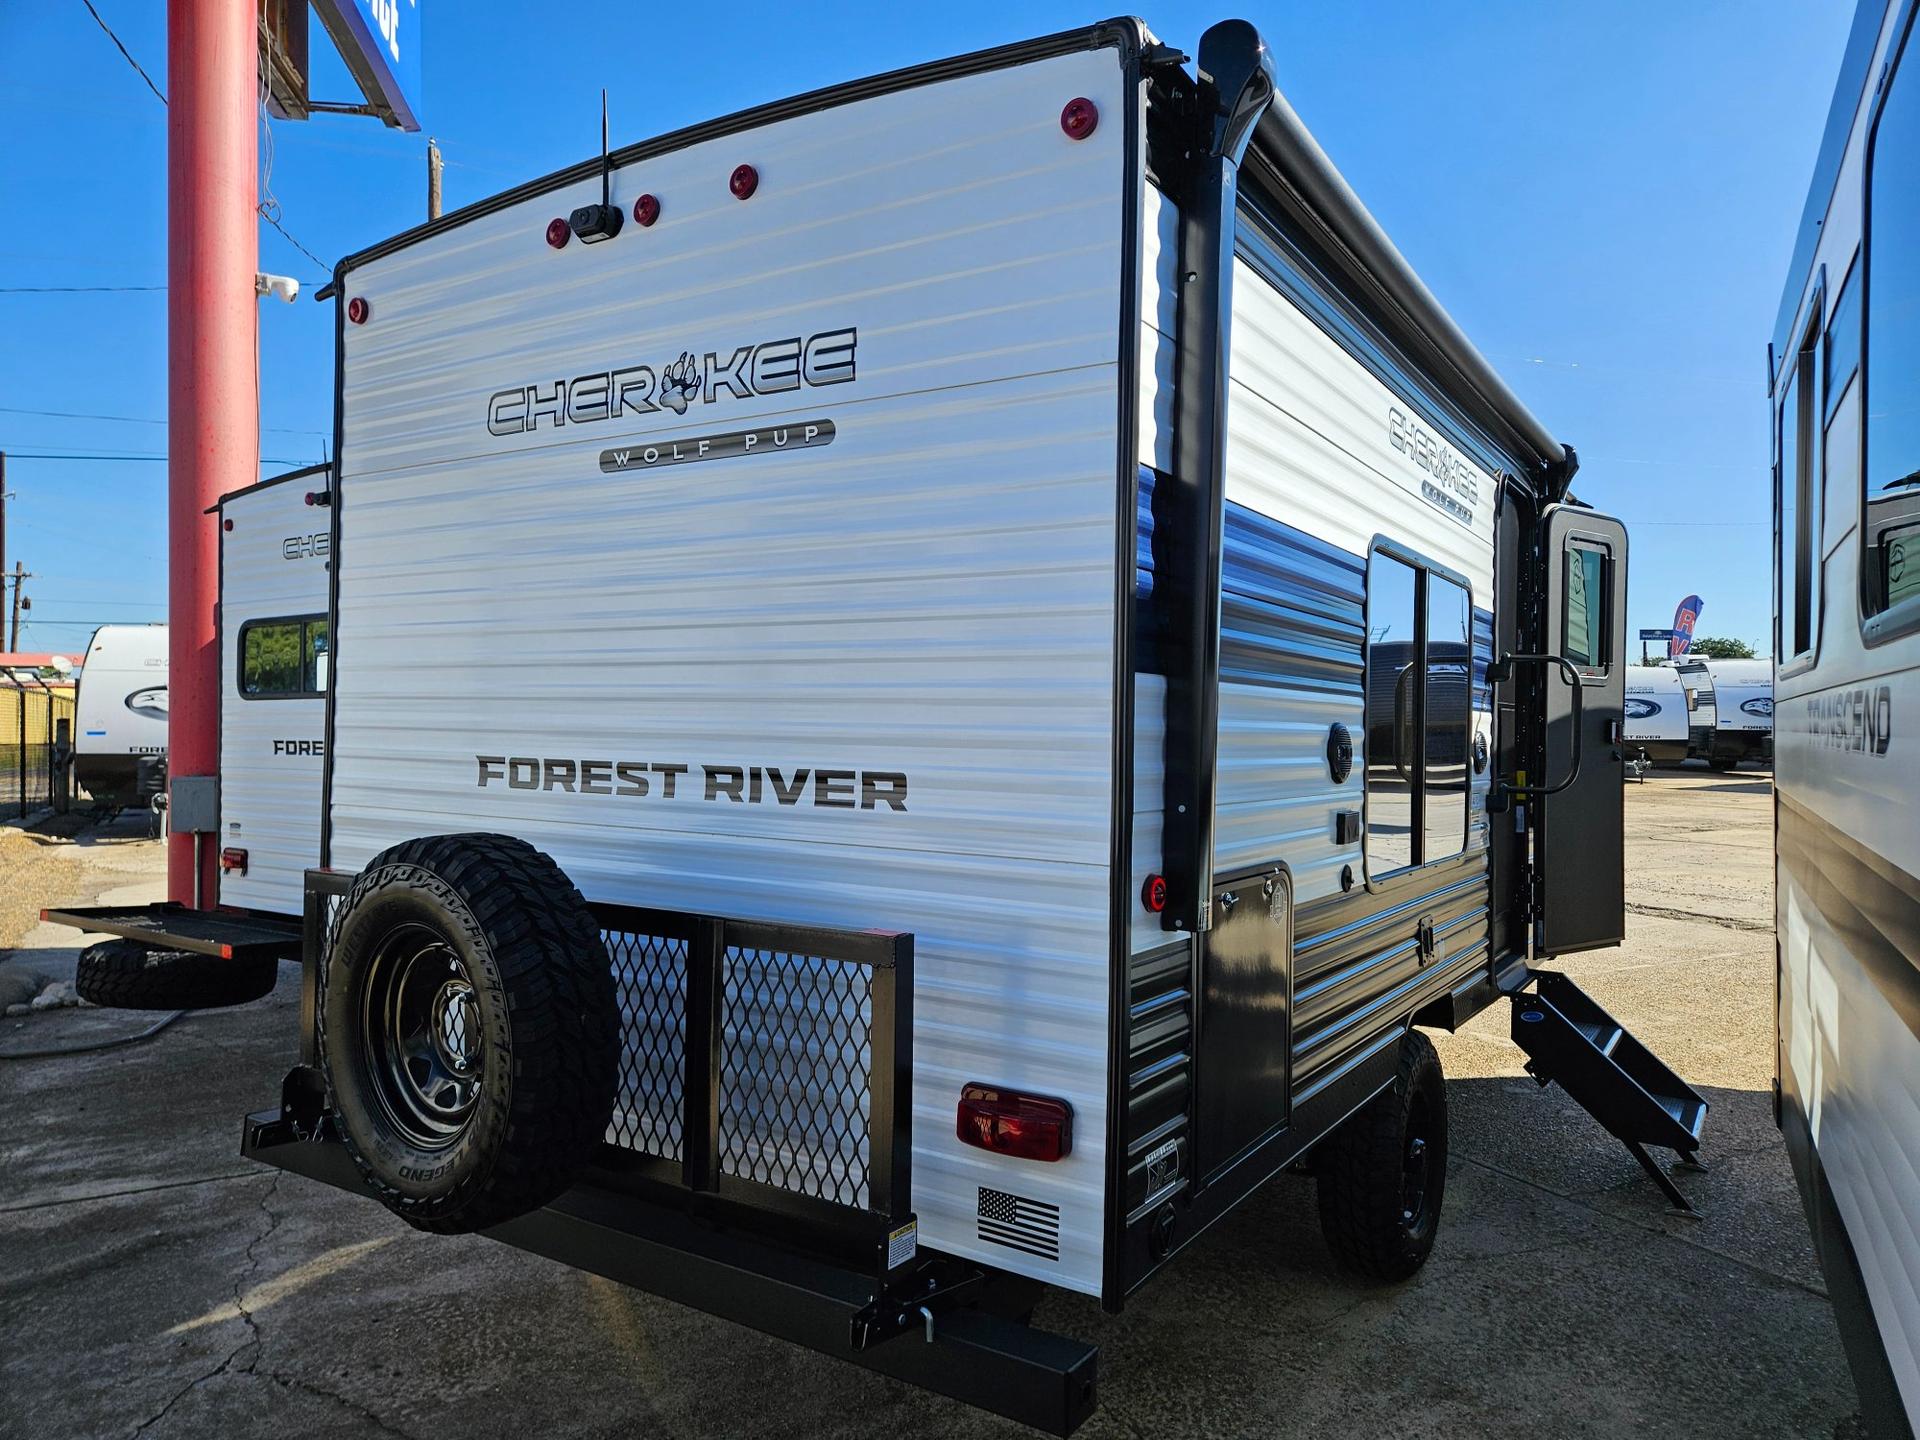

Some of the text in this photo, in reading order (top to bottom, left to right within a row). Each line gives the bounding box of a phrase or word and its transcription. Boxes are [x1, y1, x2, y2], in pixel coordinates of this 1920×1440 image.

[613, 425, 819, 467] WOLF PUP
[475, 754, 909, 812] FOREST RIVER
